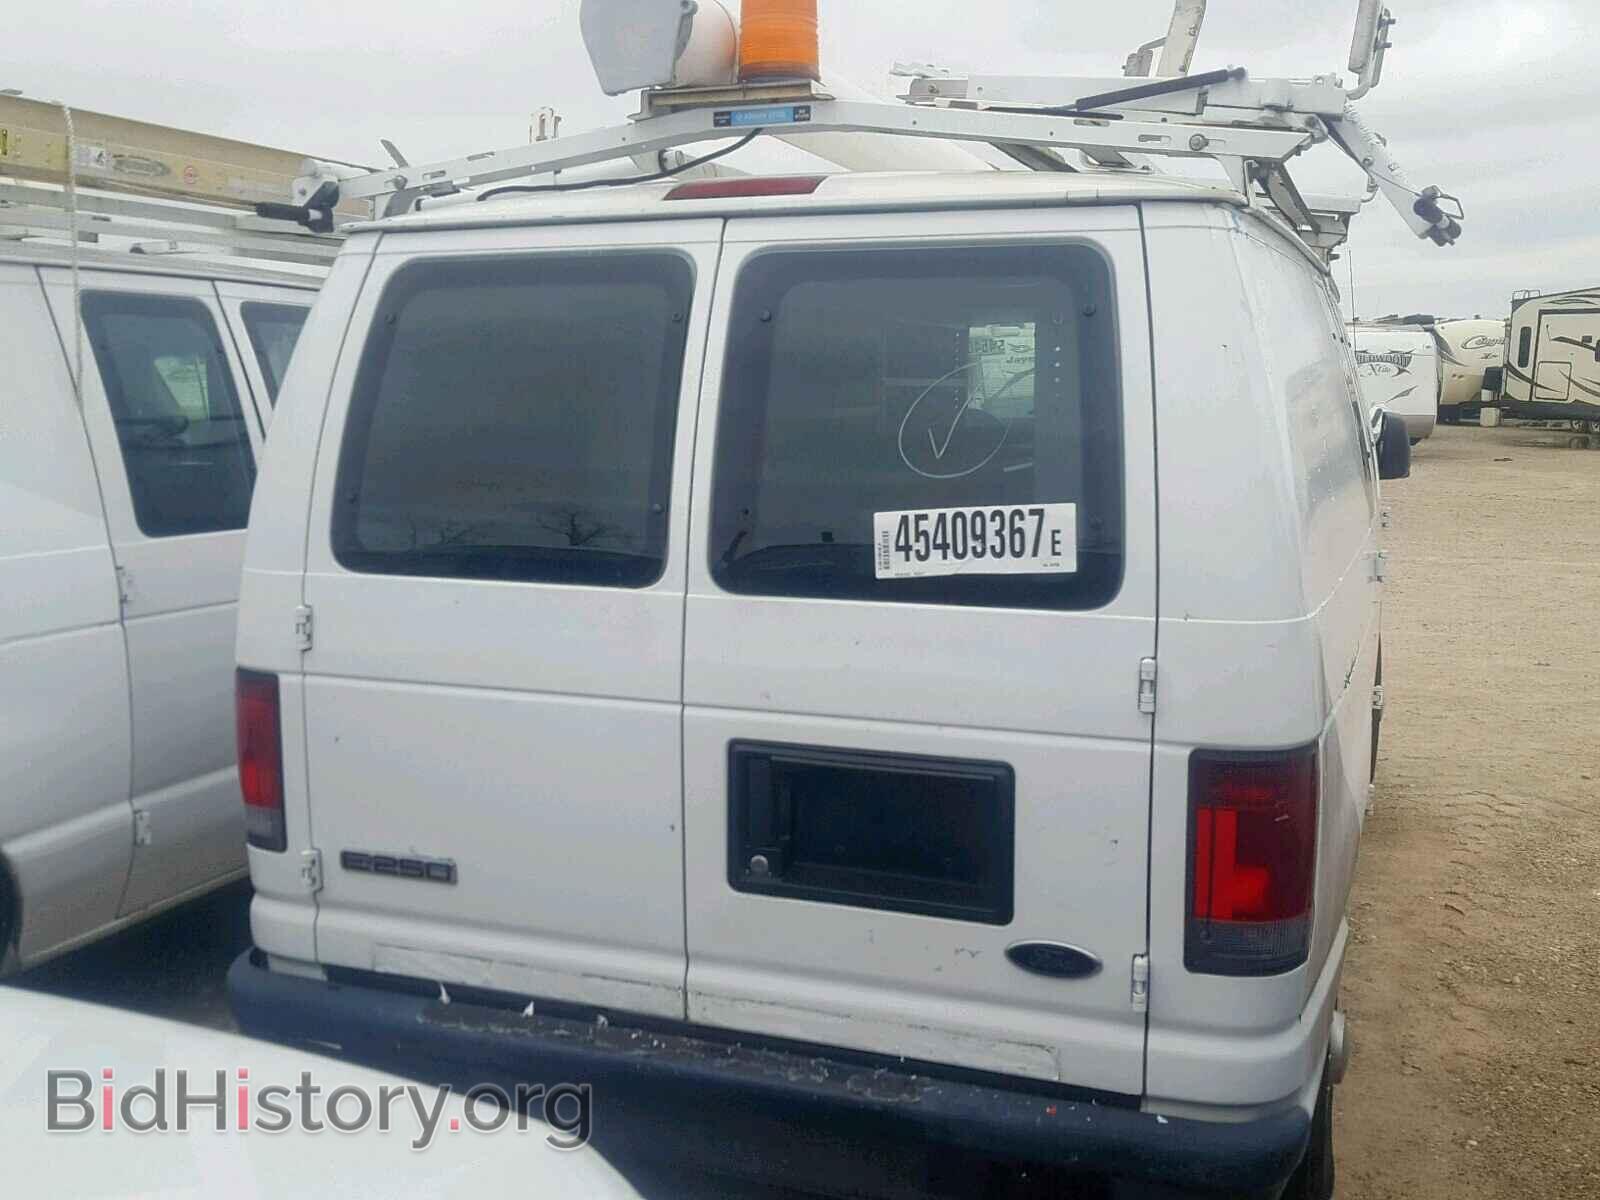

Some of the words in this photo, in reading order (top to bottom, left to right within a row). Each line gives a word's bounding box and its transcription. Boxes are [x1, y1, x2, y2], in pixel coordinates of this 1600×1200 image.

[1461, 335, 1505, 349] Couga
[895, 508, 1045, 562] 45409367
[1051, 529, 1062, 556] E
